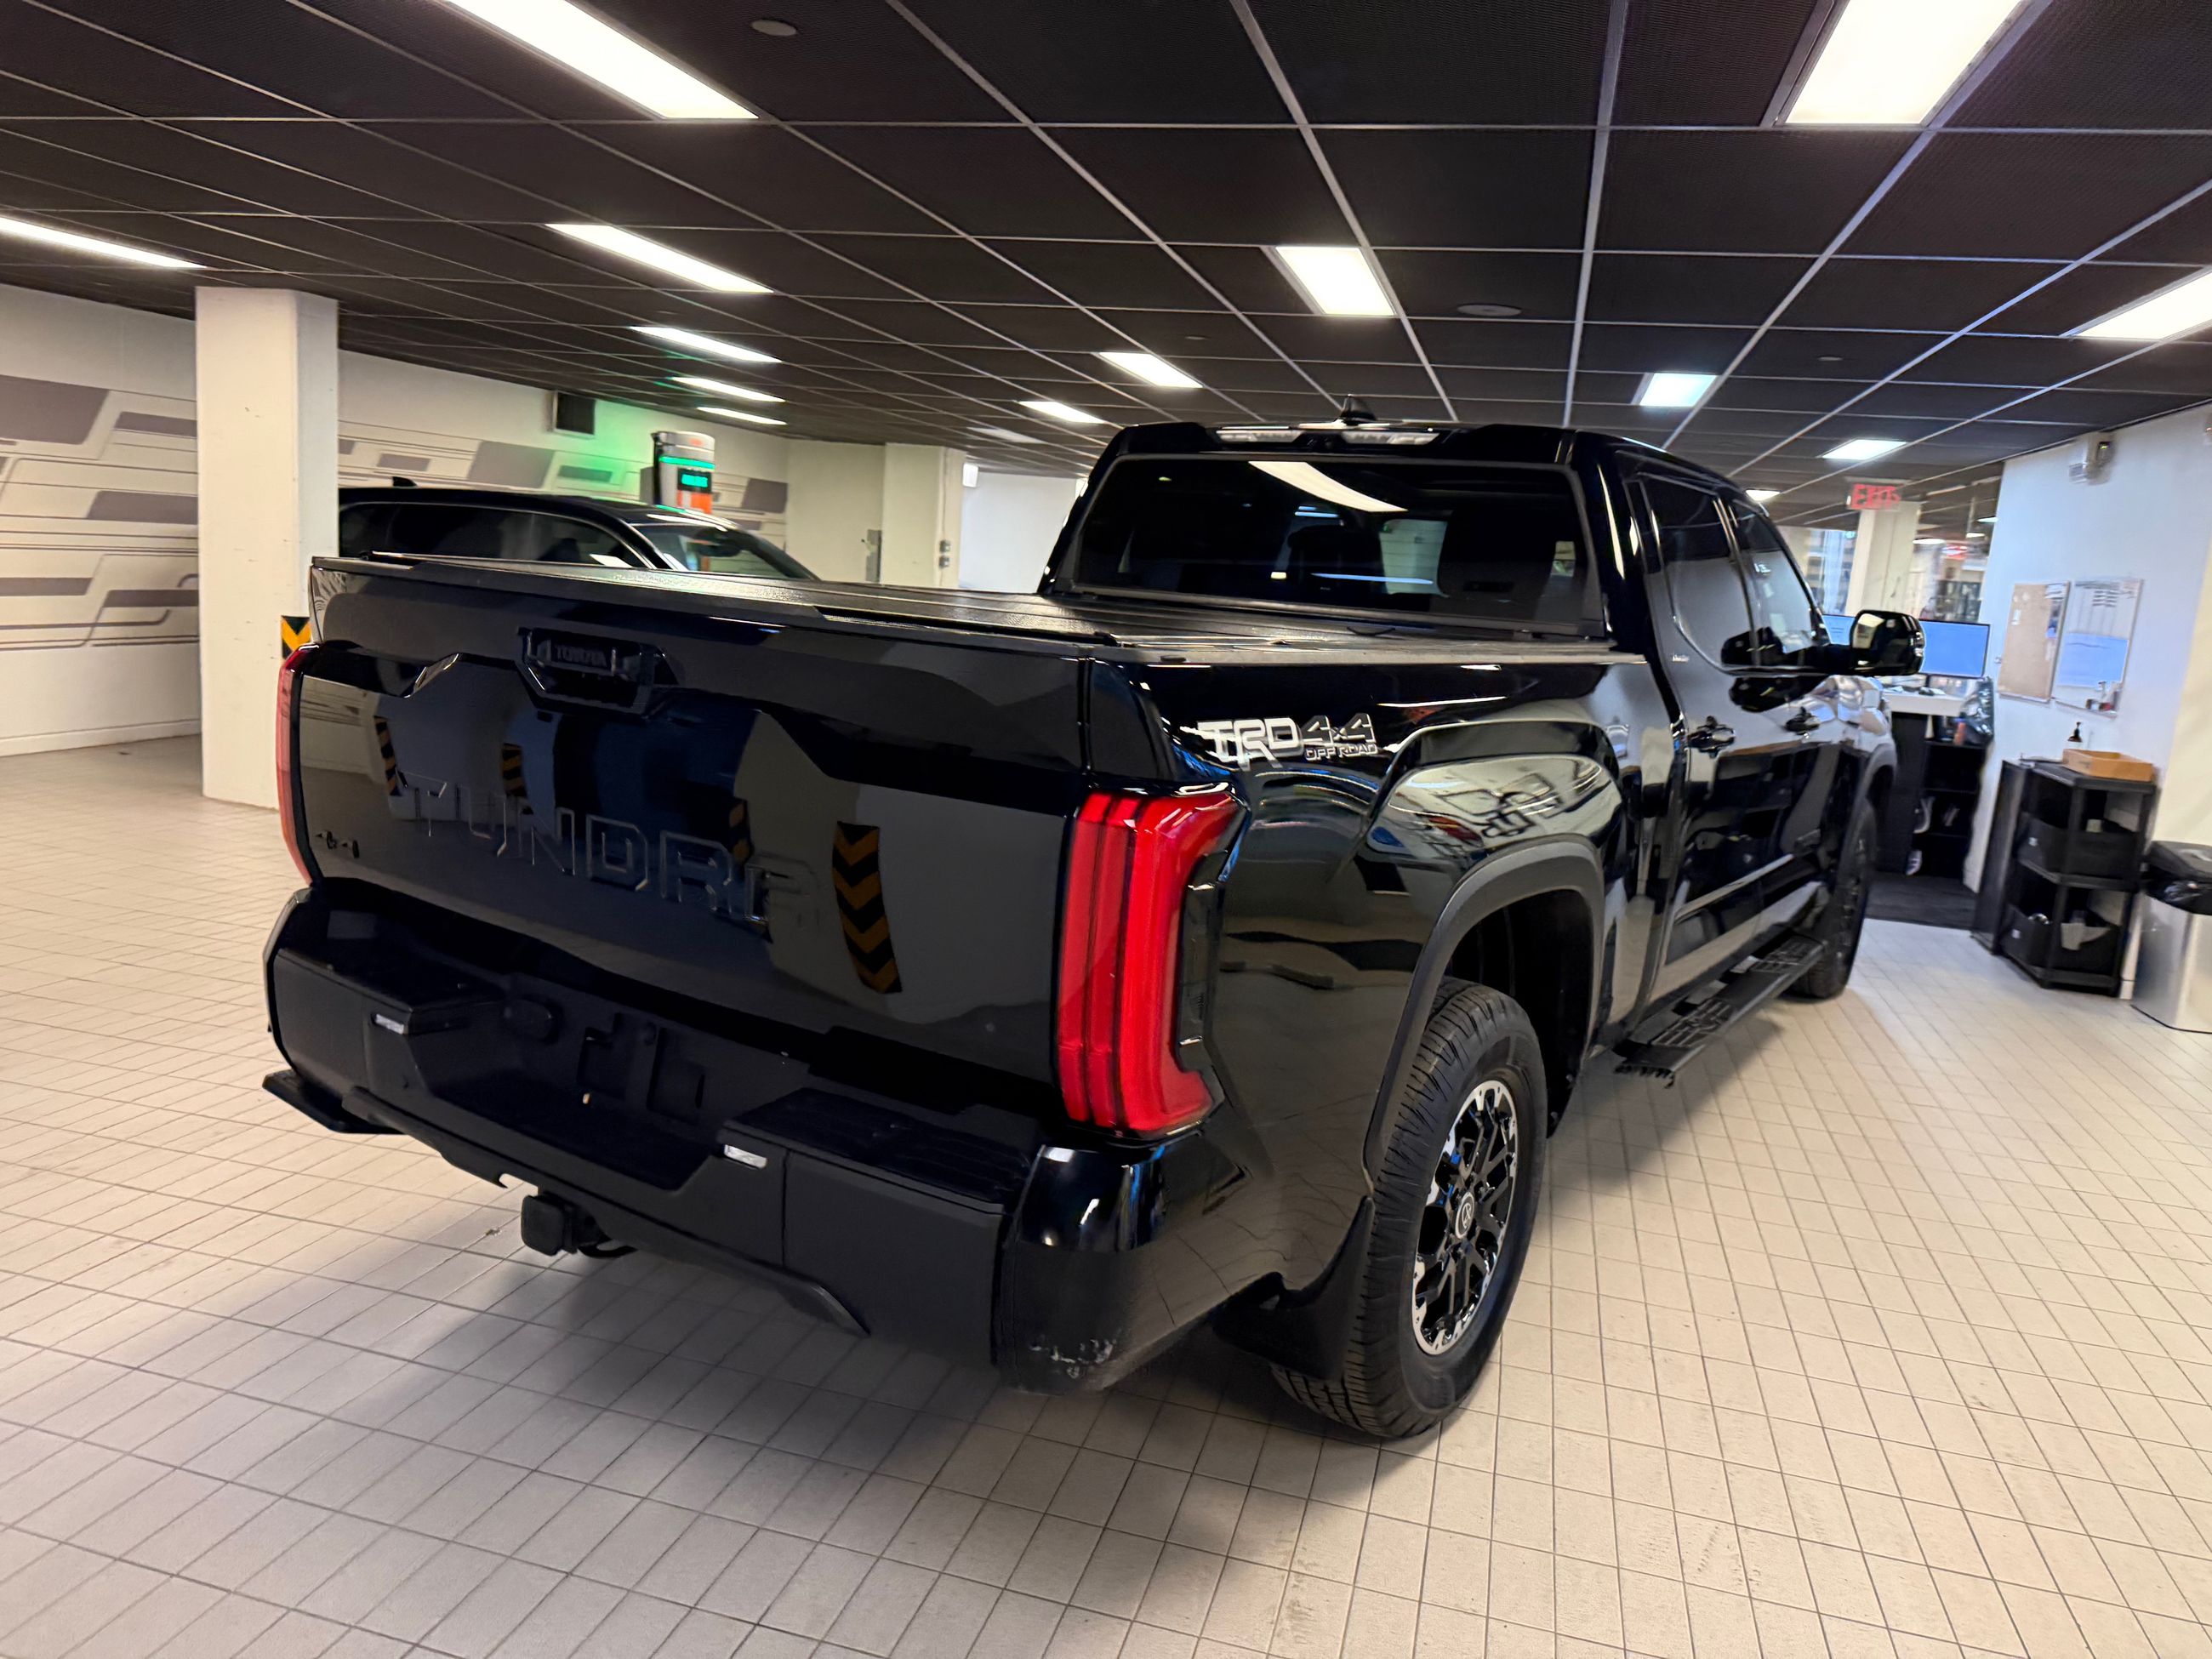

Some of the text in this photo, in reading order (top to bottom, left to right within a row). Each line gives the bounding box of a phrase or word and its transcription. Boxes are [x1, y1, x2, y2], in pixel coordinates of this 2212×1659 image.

[1196, 717, 1304, 772] TRD
[1305, 743, 1378, 761] OFF ROAD
